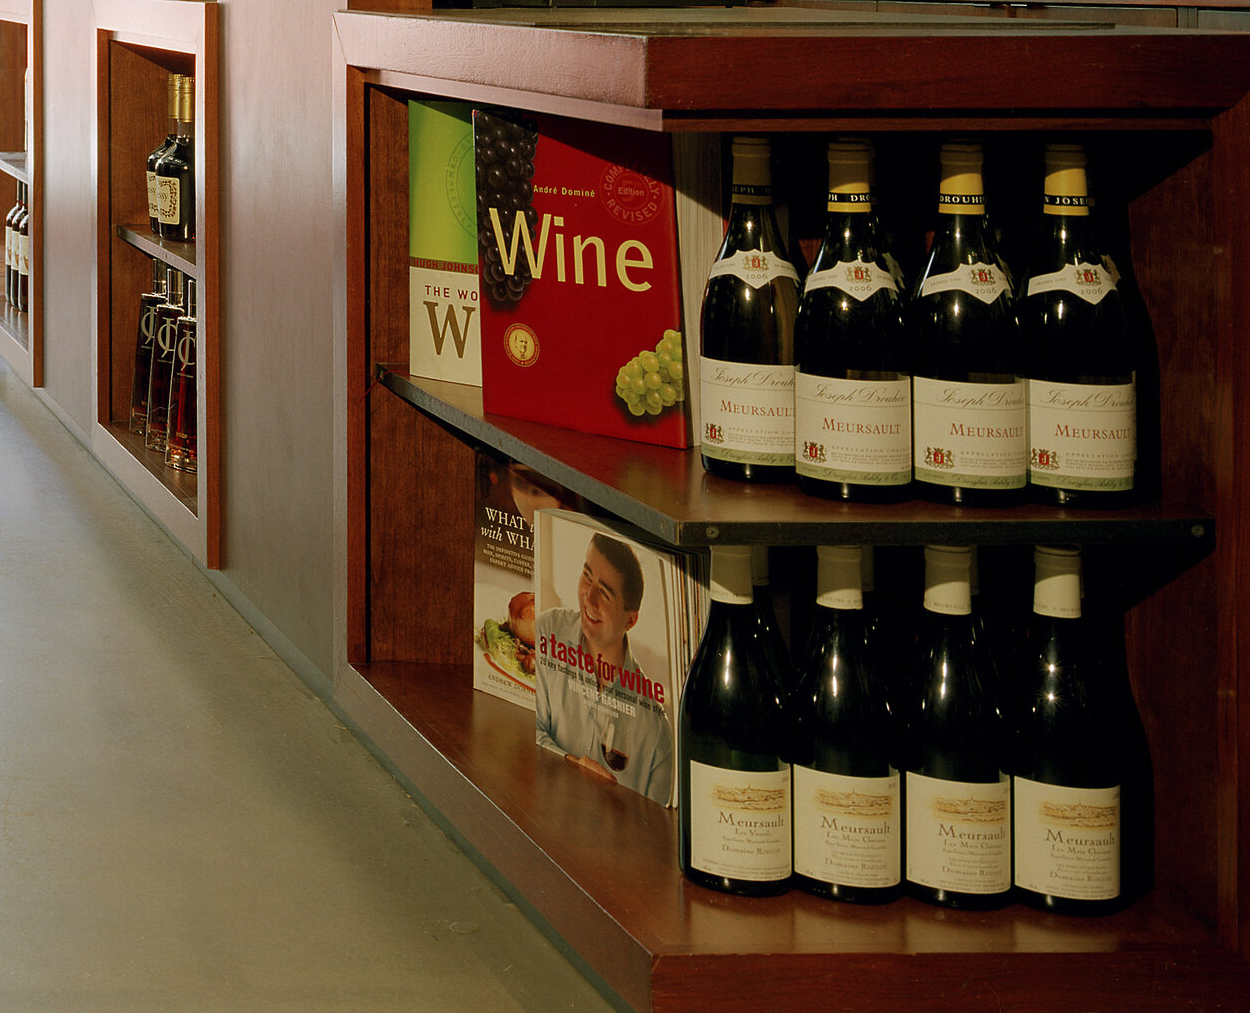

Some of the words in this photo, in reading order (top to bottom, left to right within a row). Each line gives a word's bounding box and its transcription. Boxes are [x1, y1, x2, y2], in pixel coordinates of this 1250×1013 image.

[533, 184, 558, 195] André
[561, 187, 595, 198] Dominé
[617, 186, 645, 197] Edition
[606, 198, 659, 222] REVISED
[488, 205, 654, 293] Wine
[413, 258, 440, 269] HUGH
[424, 285, 451, 298] THE
[422, 300, 477, 359] W
[711, 367, 752, 387] Joseph
[813, 383, 857, 403] Joseph
[935, 388, 988, 407] Joseph
[1041, 389, 1094, 408] Joseph
[822, 418, 902, 435] MEURSAULT
[485, 507, 526, 531] WHAT
[481, 524, 503, 542] with
[490, 558, 506, 567] EXPERT
[507, 563, 524, 573] ADVICE
[540, 635, 548, 656] a
[550, 633, 594, 674] taste
[596, 653, 616, 684] for
[618, 667, 665, 704] wine
[568, 678, 600, 702] VINCENT
[601, 692, 637, 718] GASNIER
[718, 810, 785, 828] Meursault
[821, 815, 891, 835] Meursault
[938, 824, 1006, 841] Meursault
[1045, 829, 1117, 847] Meursault
[720, 844, 755, 855] Domaine
[825, 857, 859, 869] Domaine
[941, 865, 977, 876] Domaine
[1050, 871, 1085, 882] Domaine
